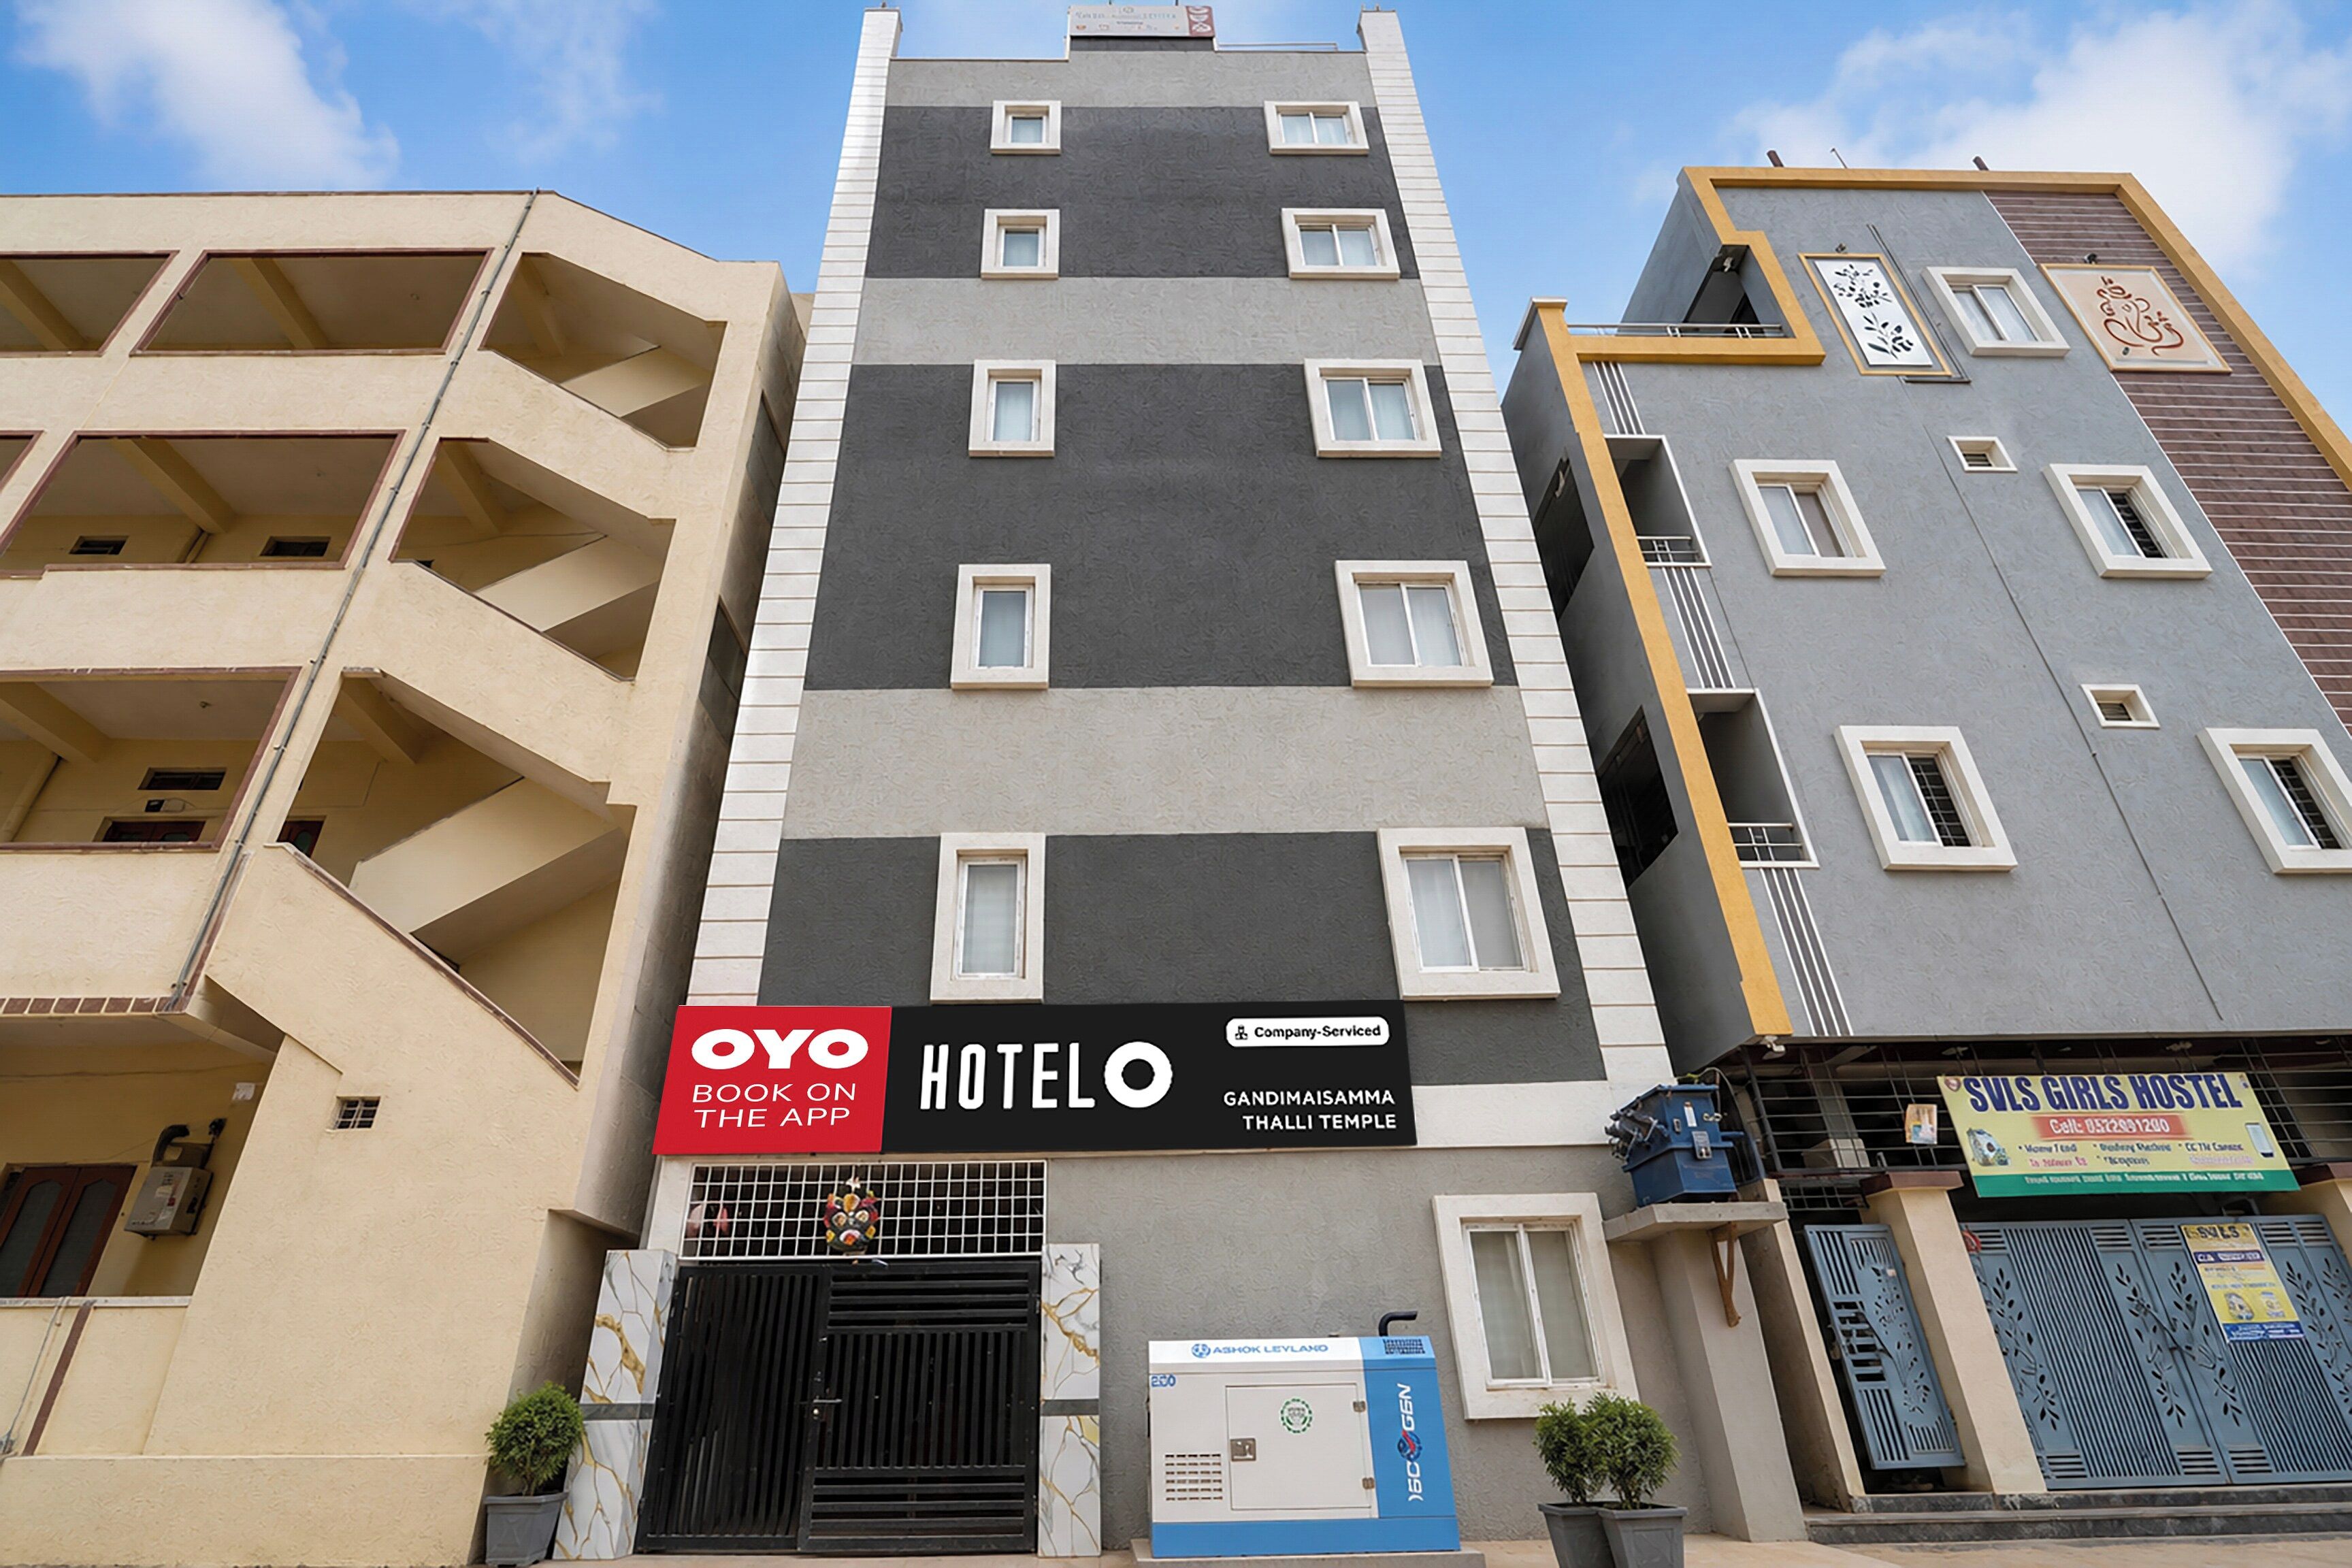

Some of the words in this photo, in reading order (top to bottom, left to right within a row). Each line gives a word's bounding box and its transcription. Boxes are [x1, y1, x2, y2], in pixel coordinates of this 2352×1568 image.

[1254, 1025, 1381, 1040] Company-Serviced
[691, 1028, 869, 1070] OYO
[920, 1043, 1096, 1110] HOTEL
[1104, 1041, 1173, 1108] O
[692, 1083, 794, 1103] BOOK
[806, 1083, 856, 1102] ON
[1224, 1090, 1395, 1107] GANDIMAISAMMA
[1963, 1077, 2041, 1112] SVLS
[2041, 1075, 2129, 1110] GIRLS
[2127, 1073, 2244, 1109] HOSTEL
[693, 1109, 768, 1128] THE
[779, 1107, 850, 1127] APP
[1242, 1115, 1313, 1130] THALLI
[1318, 1113, 1396, 1130] TEMPLE
[1264, 1344, 1328, 1353] LEYLAND
